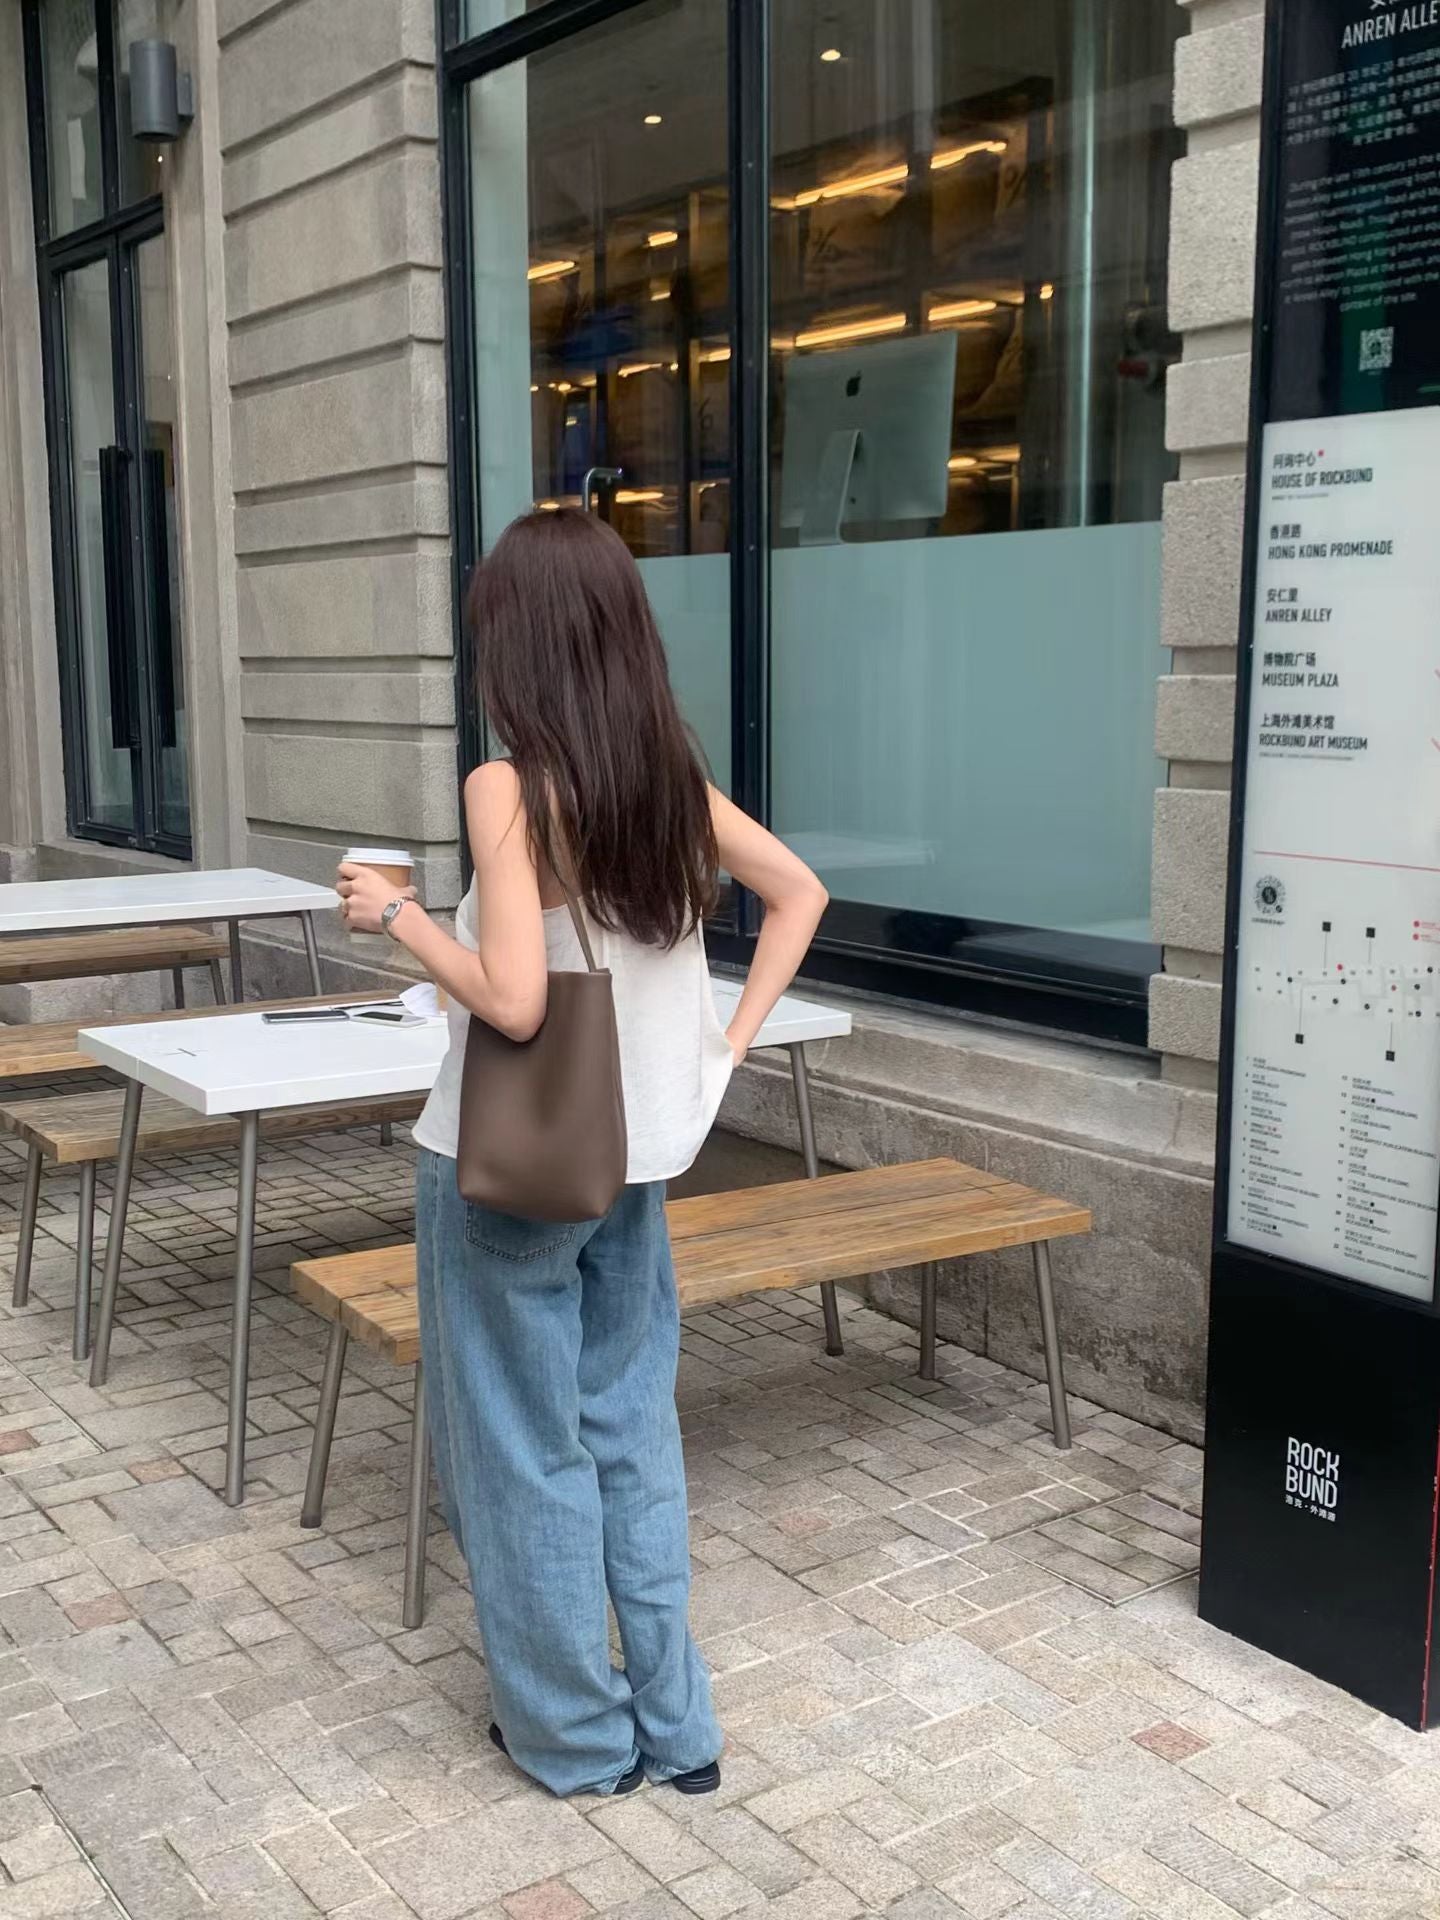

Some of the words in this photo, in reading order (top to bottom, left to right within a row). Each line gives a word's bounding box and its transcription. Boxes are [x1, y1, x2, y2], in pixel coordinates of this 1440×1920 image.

[1341, 12, 1396, 49] ANREN
[1399, 0, 1440, 33] ALLE
[1271, 473, 1303, 489] HOUSE
[1305, 472, 1318, 487] OF
[1320, 467, 1373, 486] ROCKBUND
[1268, 545, 1296, 560] HONG
[1299, 543, 1327, 558] KONG
[1330, 540, 1393, 557] PROMENADE
[1266, 588, 1299, 604] 安仁里
[1265, 609, 1299, 623] ANREN
[1301, 608, 1332, 622] ALLEY
[1262, 673, 1304, 687] MUSEUM
[1307, 673, 1339, 688] PLAZA
[1260, 713, 1335, 730] 上海外滩美术馆
[1259, 733, 1306, 748] ROCKBUND
[1308, 736, 1325, 749] ART
[1327, 736, 1368, 750] MUSEUM
[1287, 1436, 1340, 1482] ROCK
[1285, 1464, 1338, 1508] BUND
